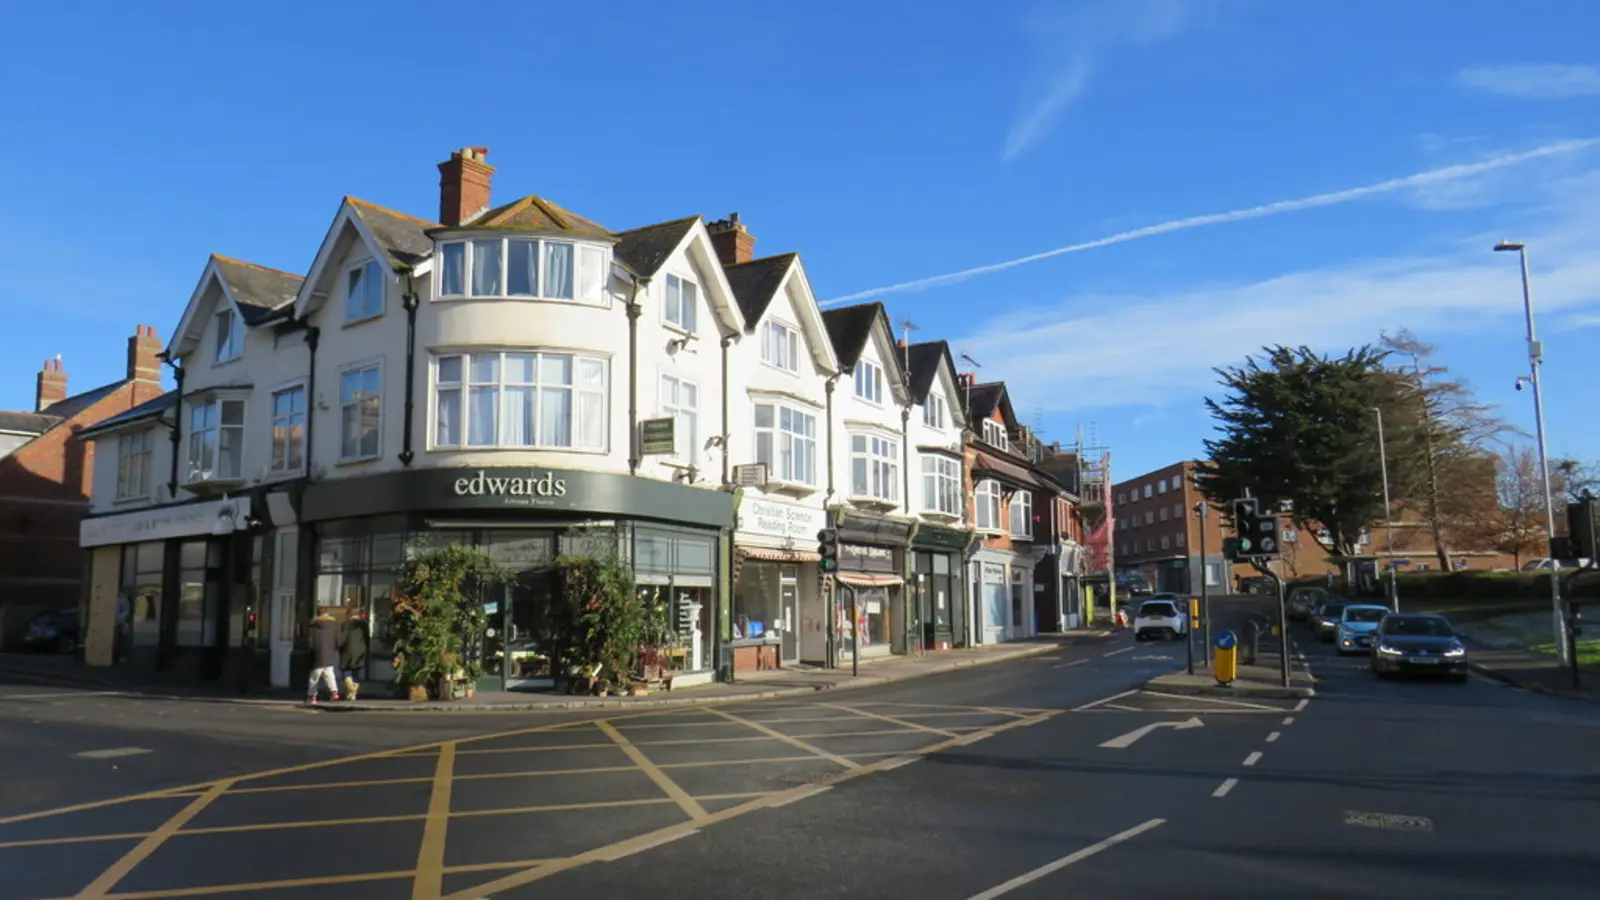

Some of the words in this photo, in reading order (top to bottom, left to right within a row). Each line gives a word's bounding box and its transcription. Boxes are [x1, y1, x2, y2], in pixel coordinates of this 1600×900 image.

[454, 470, 567, 497] edwards
[752, 502, 784, 518] Christian
[786, 507, 812, 522] Science
[757, 516, 786, 534] Reading
[787, 520, 807, 534] Room
